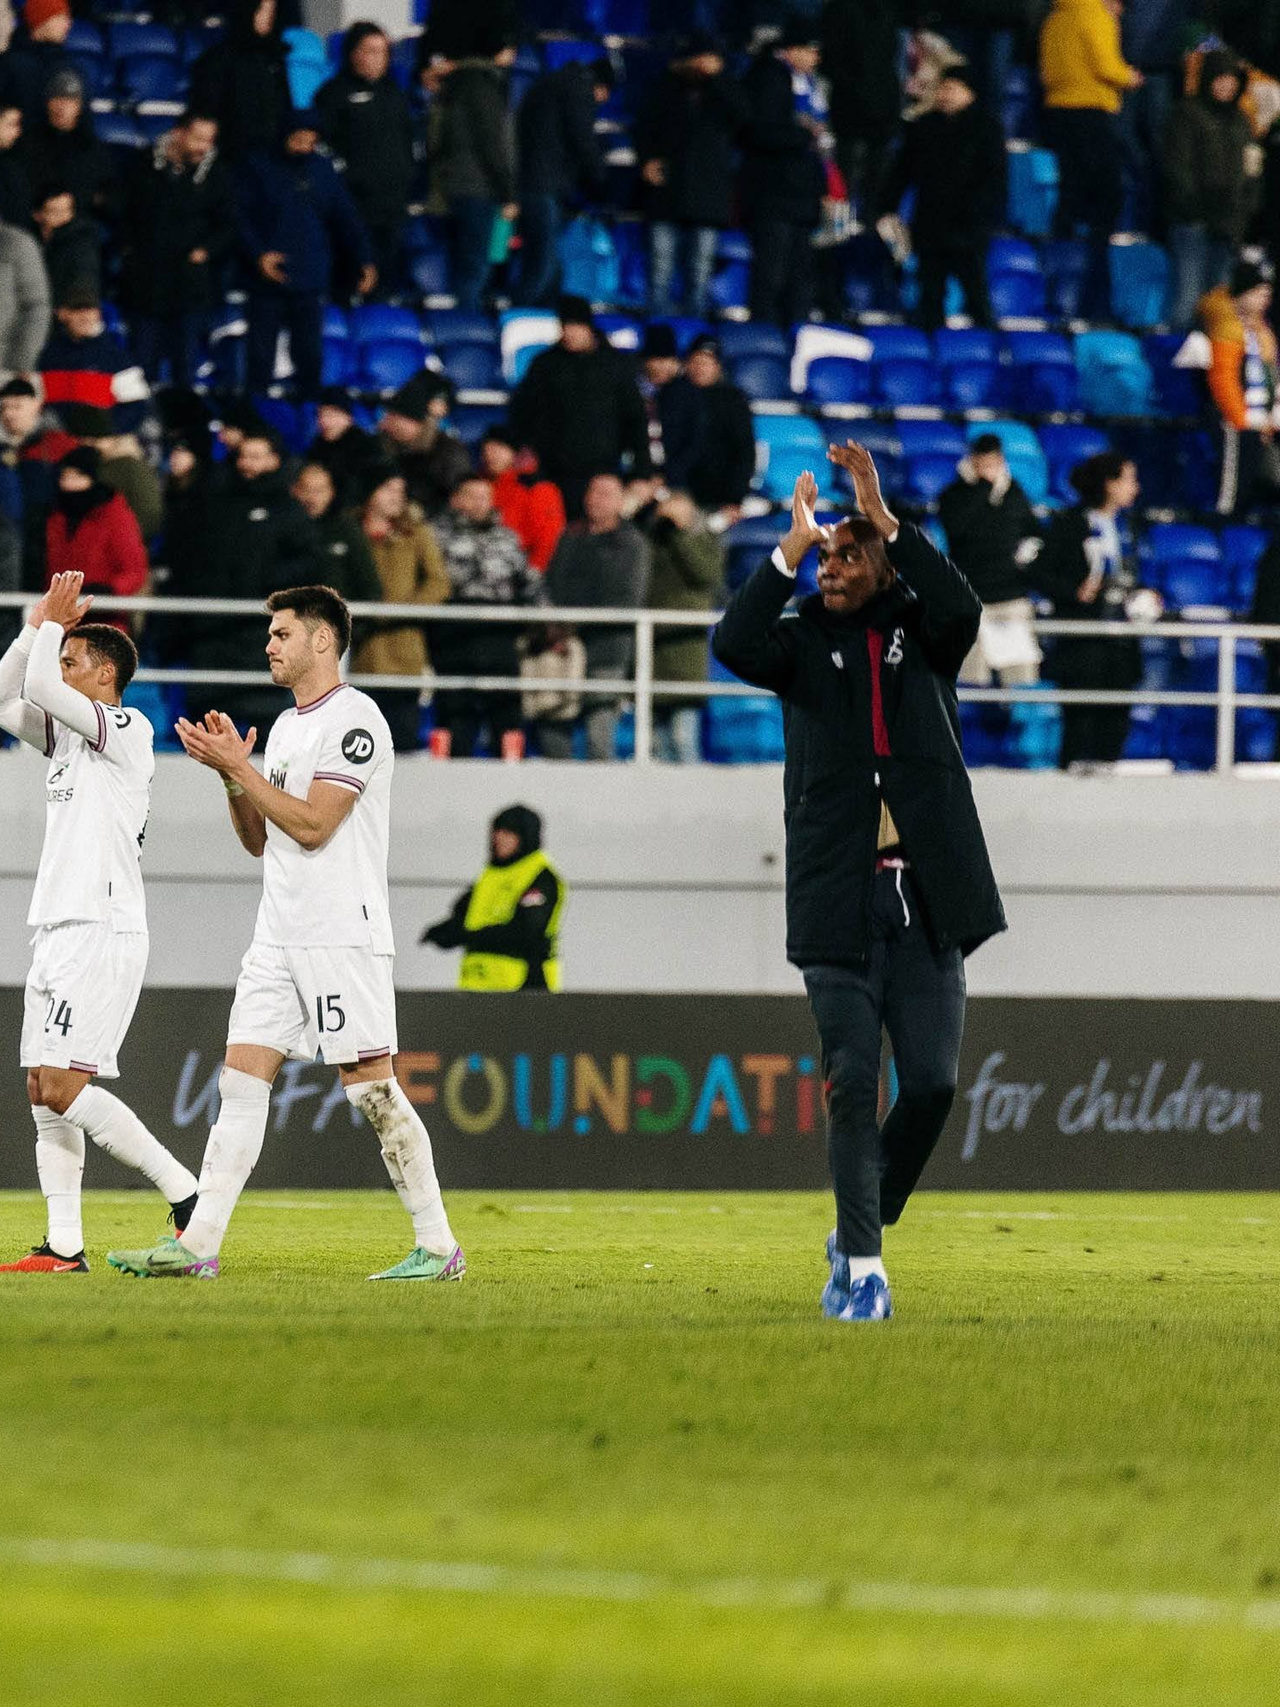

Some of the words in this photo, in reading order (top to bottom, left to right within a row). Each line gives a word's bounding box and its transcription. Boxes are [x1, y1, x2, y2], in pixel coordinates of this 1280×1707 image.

[344, 735, 373, 758] JD
[316, 994, 346, 1033] 15
[961, 1051, 1046, 1161] for
[1057, 1057, 1263, 1135] children
